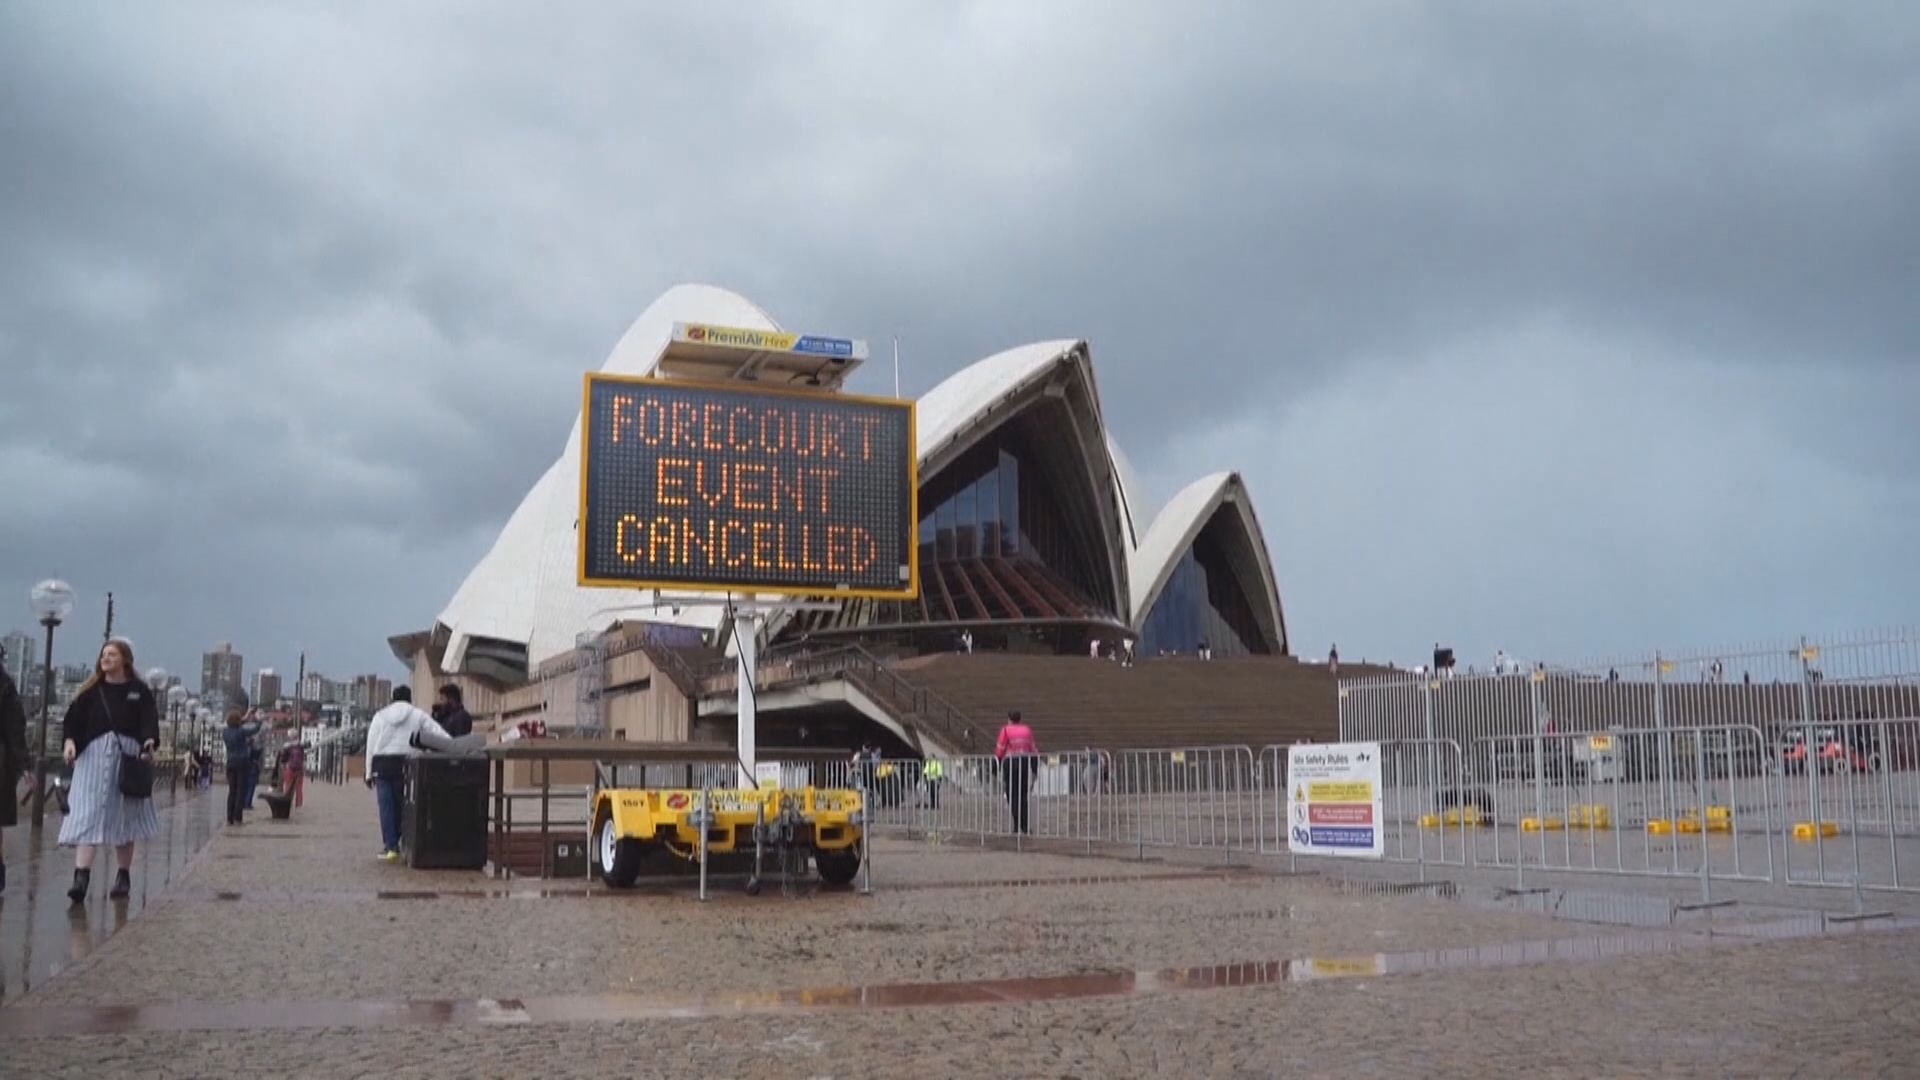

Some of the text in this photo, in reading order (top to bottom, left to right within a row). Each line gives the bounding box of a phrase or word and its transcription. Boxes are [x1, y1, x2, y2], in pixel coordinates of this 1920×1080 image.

[611, 394, 880, 461] FORECOURT
[656, 456, 839, 514] EVENT
[615, 513, 876, 573] CANCELLED
